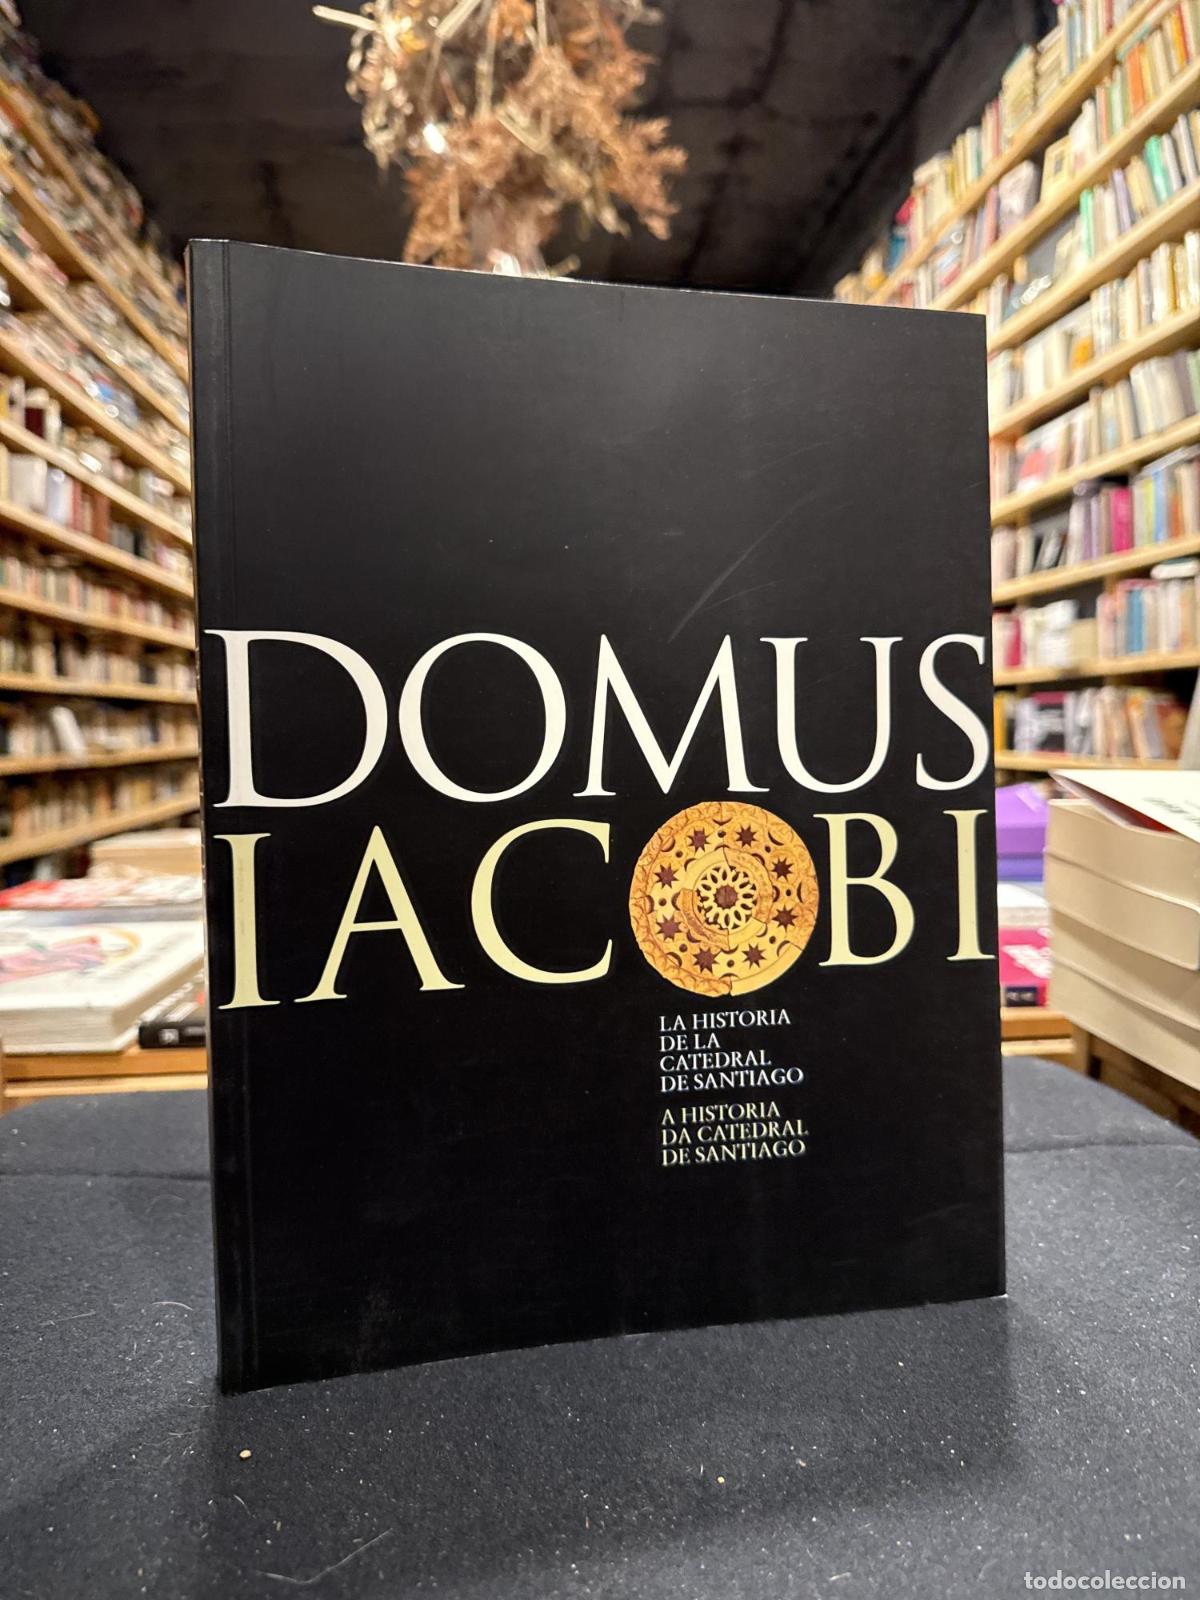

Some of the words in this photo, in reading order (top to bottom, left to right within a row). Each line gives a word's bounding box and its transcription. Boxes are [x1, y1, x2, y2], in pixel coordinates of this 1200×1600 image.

[204, 629, 990, 808] DOMUS
[659, 1014, 687, 1032] LA
[692, 1008, 791, 1030] HISTORIA
[660, 1034, 688, 1053] DE
[694, 1032, 721, 1050] LA
[659, 1049, 772, 1073] CATEDRAL
[660, 1074, 689, 1093] DE
[693, 1066, 804, 1091] SANTIAGO
[661, 1108, 675, 1126] A
[681, 1101, 781, 1124] HISTORIA
[662, 1127, 692, 1146] DA
[697, 1119, 809, 1143] CATEDRAL
[662, 1148, 691, 1167] DE
[695, 1139, 806, 1164] SANTIAGO
